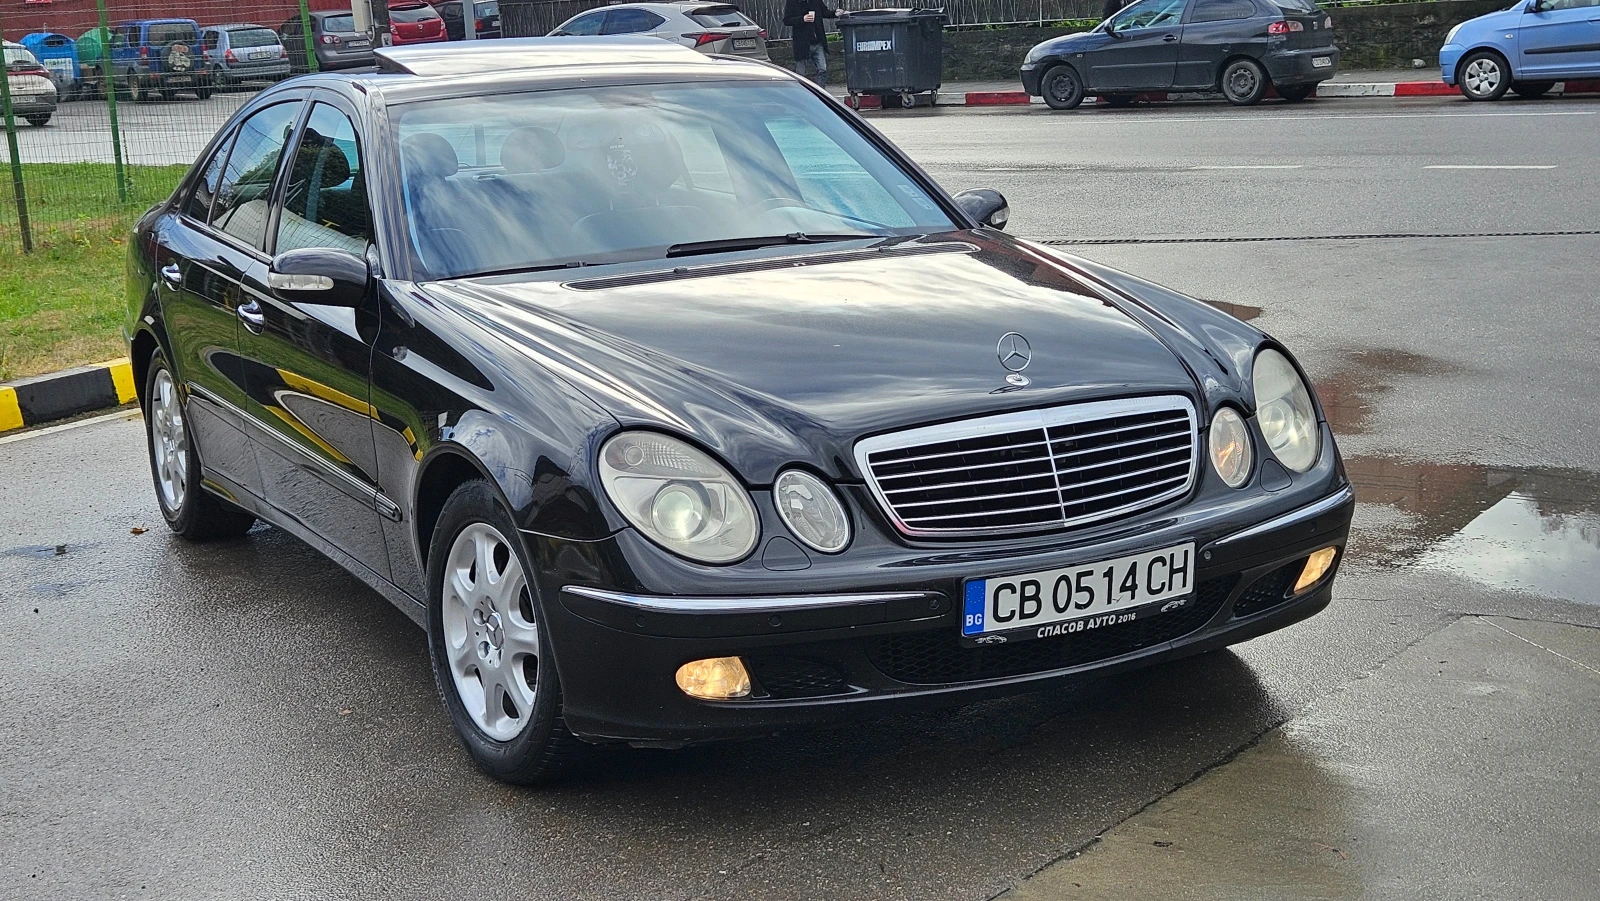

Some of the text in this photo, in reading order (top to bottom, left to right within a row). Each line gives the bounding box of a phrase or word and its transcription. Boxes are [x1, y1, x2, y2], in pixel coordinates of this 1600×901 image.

[993, 549, 1189, 623] CB 0514 CH
[966, 613, 983, 627] BG
[1037, 612, 1136, 638] СПАСОВ АУТО 2016
